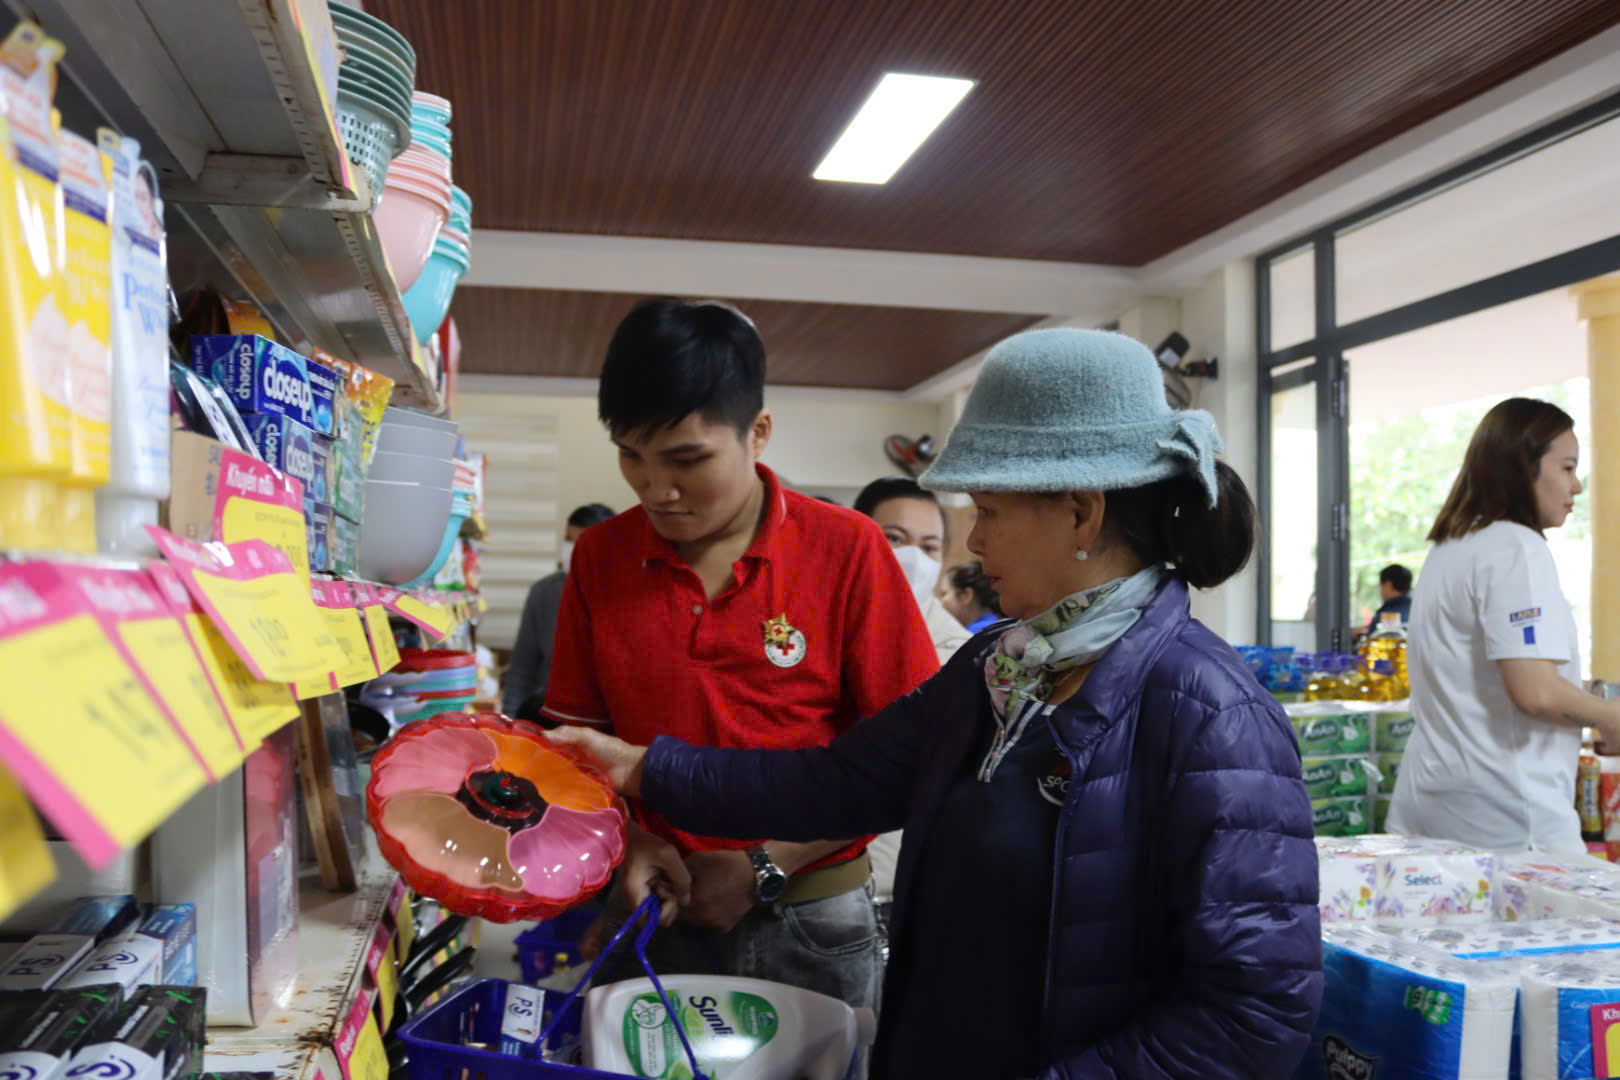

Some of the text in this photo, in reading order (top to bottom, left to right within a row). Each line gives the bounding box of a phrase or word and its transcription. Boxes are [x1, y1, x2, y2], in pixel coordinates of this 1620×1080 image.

[235, 343, 254, 399] closeup
[263, 358, 312, 422] closeup
[266, 424, 281, 466] close
[1405, 873, 1442, 887] Select
